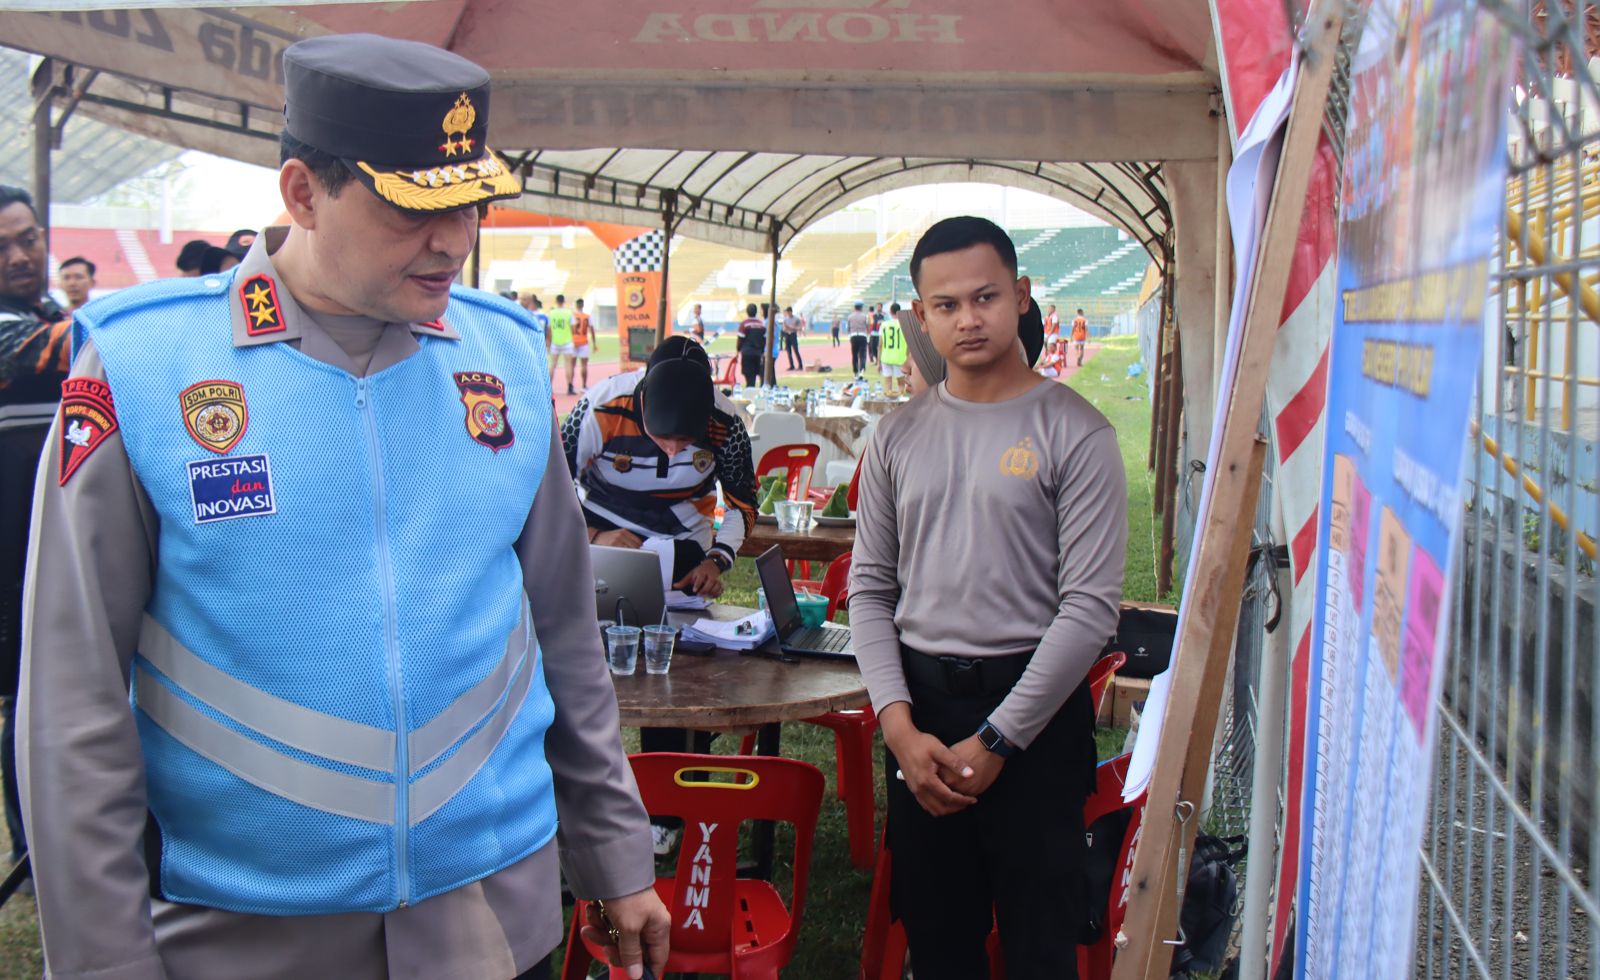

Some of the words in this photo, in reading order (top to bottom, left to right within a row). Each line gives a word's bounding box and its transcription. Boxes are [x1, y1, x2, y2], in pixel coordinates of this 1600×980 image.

[883, 326, 900, 349] 131
[461, 373, 503, 389] ACEH
[187, 390, 207, 405] SDM
[209, 387, 239, 399] POLRI
[191, 459, 267, 480] PRESTASI
[231, 479, 264, 494] dan
[197, 494, 271, 517] INOVASI
[682, 822, 719, 930] YANMA
